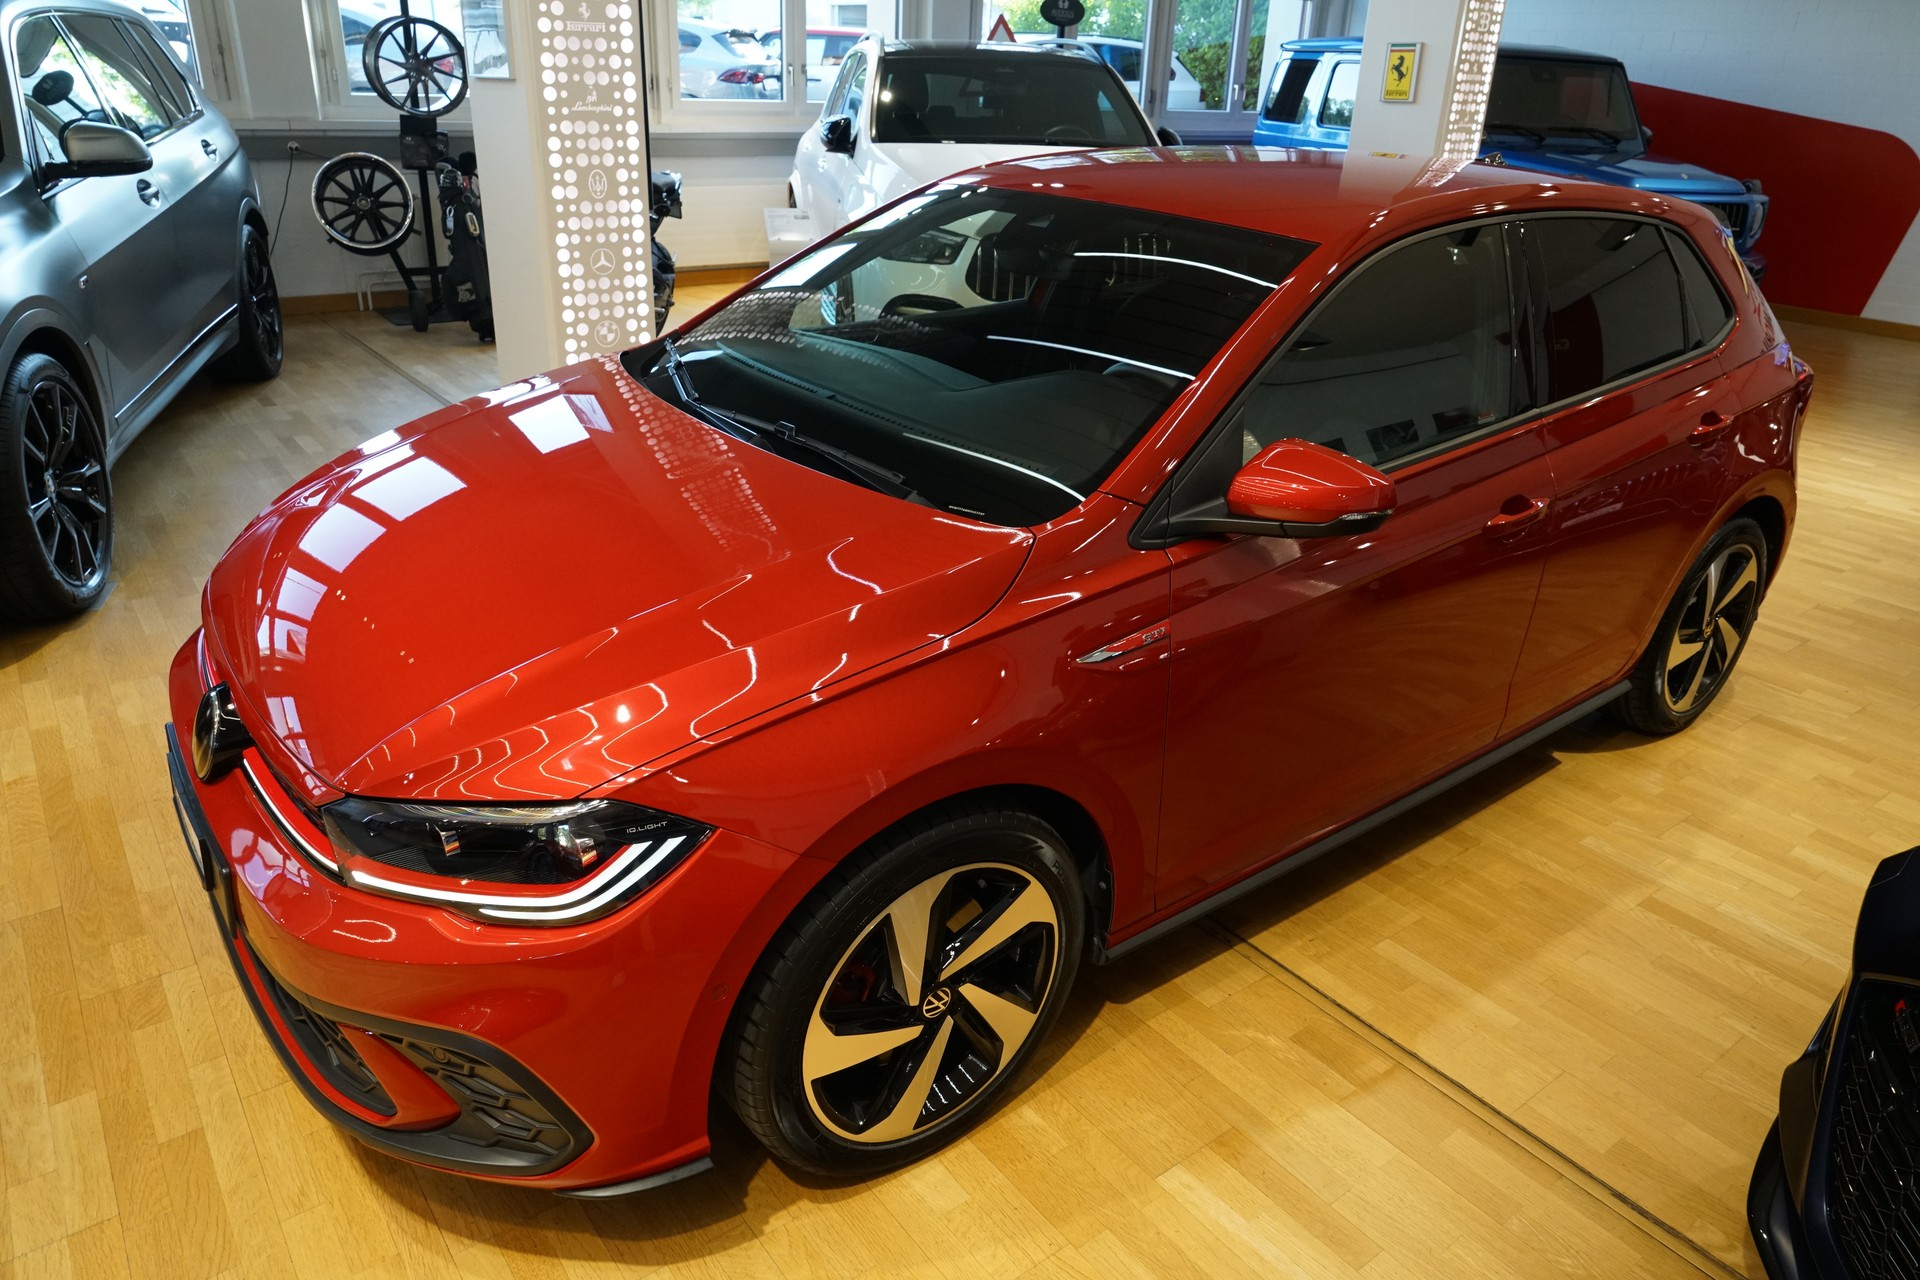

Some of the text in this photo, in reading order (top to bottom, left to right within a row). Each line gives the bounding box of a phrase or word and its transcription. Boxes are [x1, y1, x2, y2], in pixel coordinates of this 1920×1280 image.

[565, 21, 606, 33] Ferrari
[571, 102, 613, 113] Lamborghini
[626, 821, 668, 834] IQ.LIGHT
